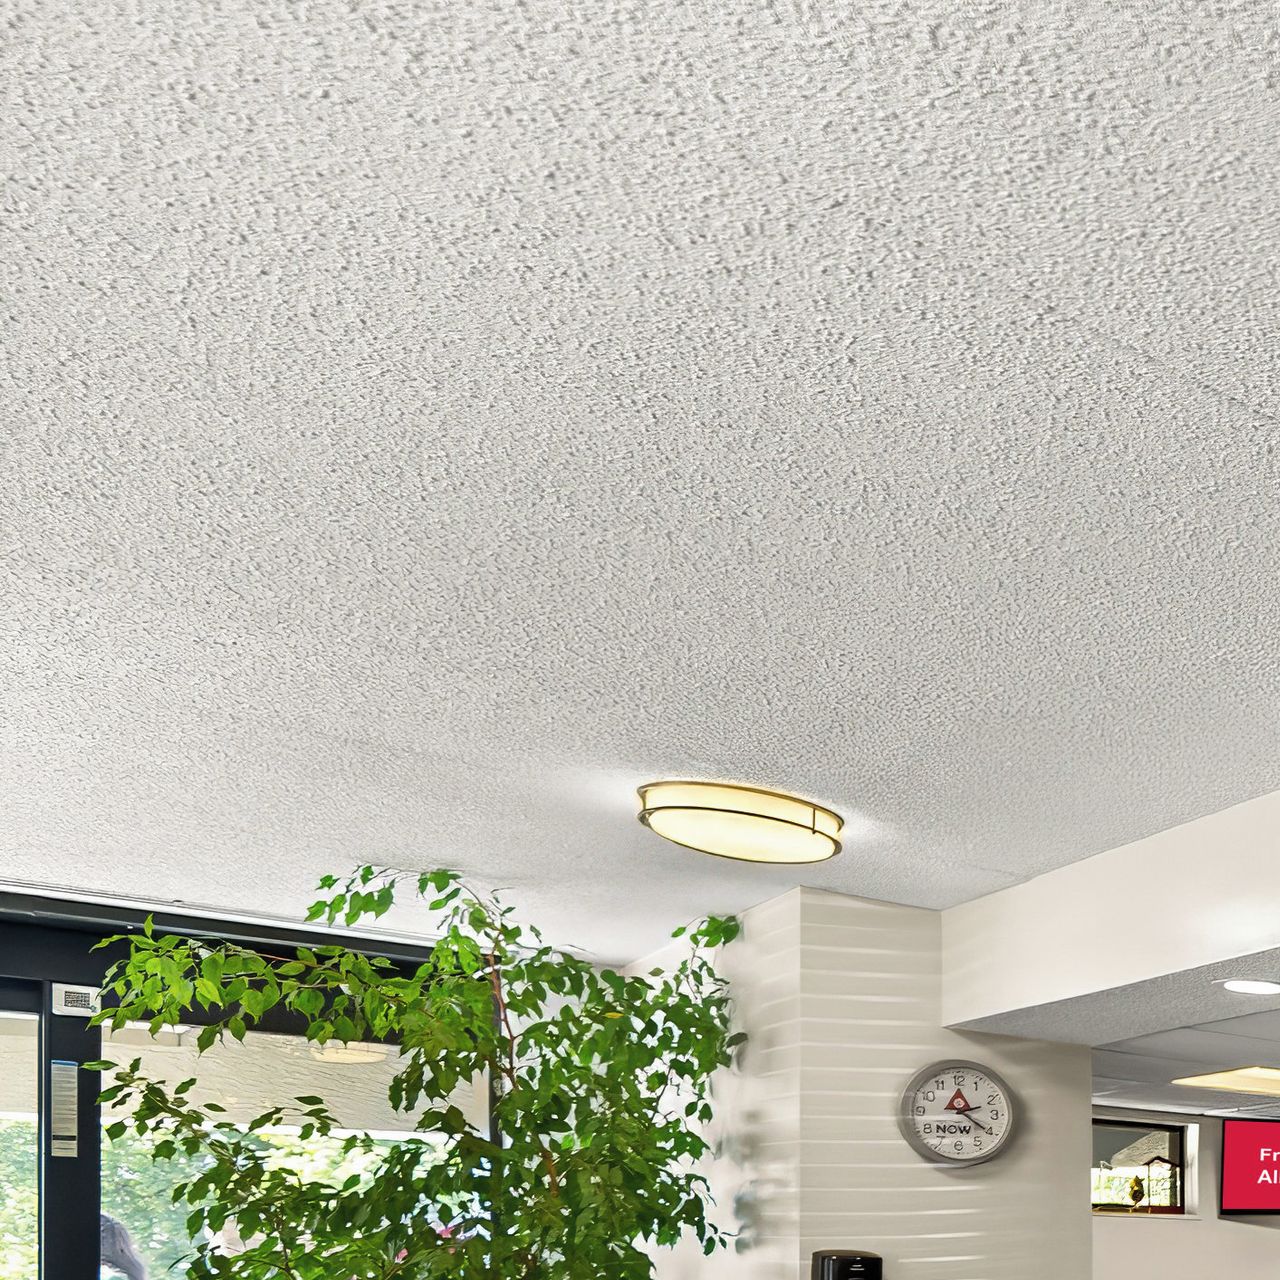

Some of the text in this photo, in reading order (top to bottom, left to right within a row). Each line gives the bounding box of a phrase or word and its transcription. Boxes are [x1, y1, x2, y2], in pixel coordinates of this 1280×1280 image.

[935, 1080, 945, 1091] 11
[953, 1075, 965, 1087] 12
[990, 1110, 999, 1120] 3
[923, 1124, 932, 1134] 8
[936, 1125, 972, 1135] NOW
[954, 1140, 963, 1152] 6
[973, 1136, 982, 1147] 5
